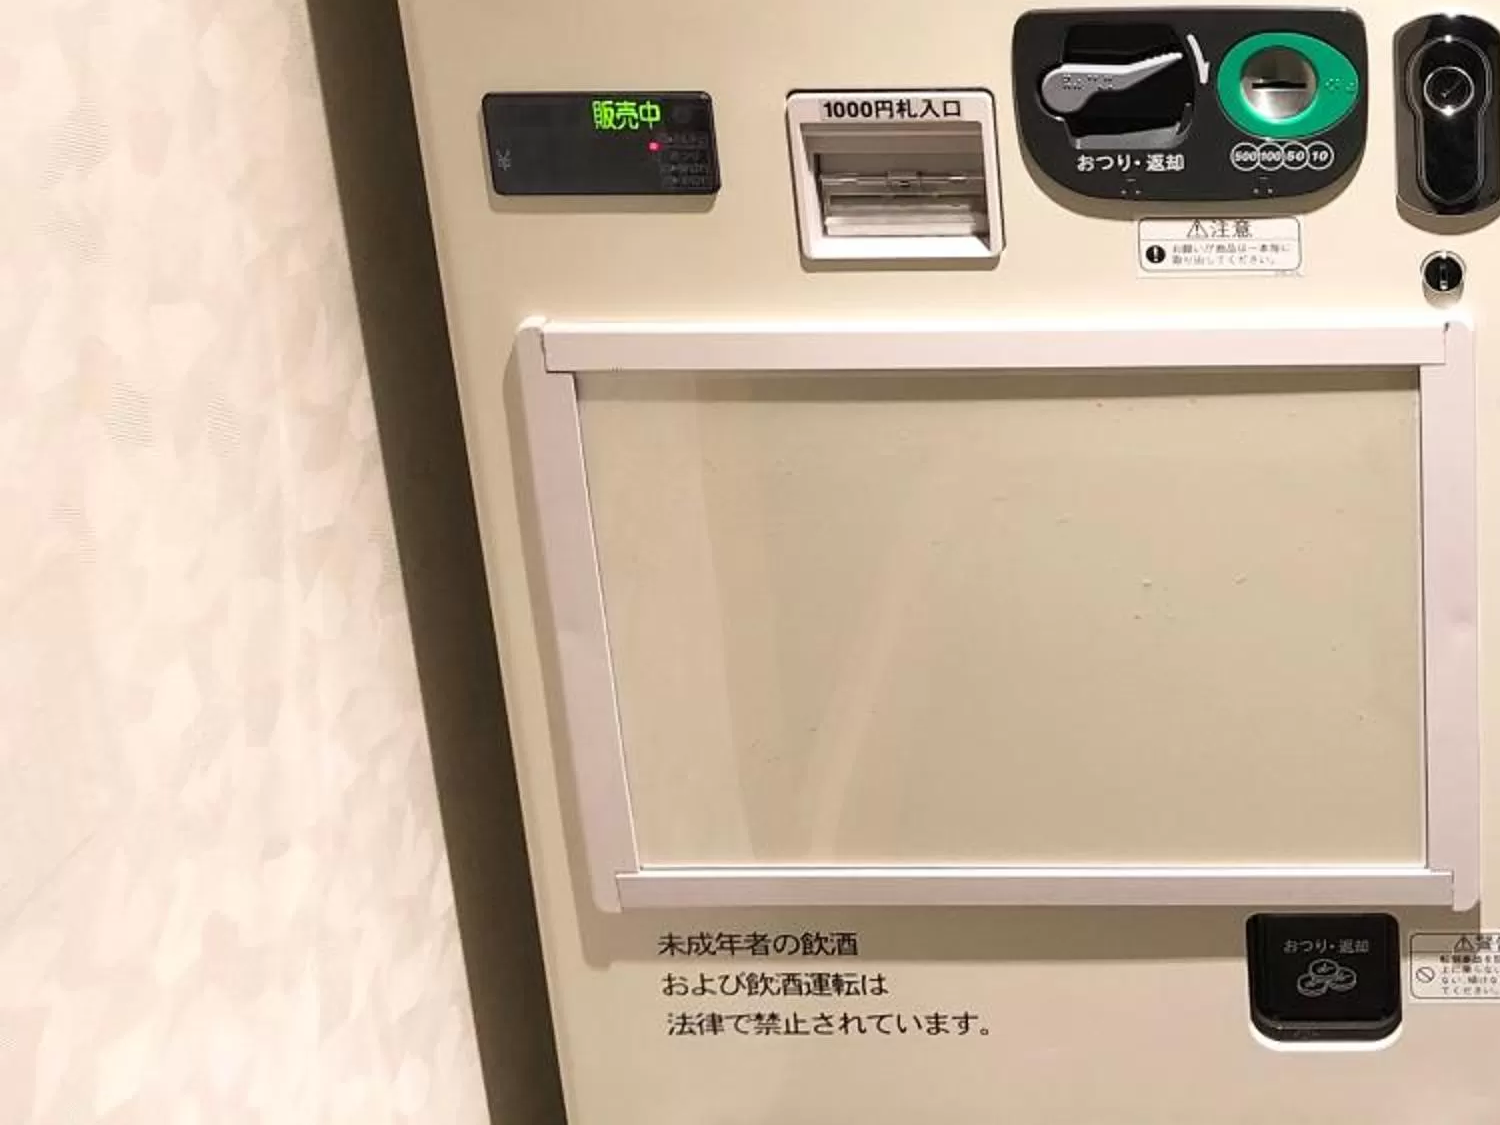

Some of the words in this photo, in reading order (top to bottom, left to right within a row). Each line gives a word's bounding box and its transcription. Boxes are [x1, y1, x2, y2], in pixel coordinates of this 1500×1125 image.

[592, 100, 661, 130] 販売中
[823, 99, 962, 120] 1000円札入口
[1077, 153, 1185, 172] おつり・返却
[1235, 150, 1257, 163] 500
[1260, 150, 1281, 163] 100
[1286, 150, 1305, 162] 50
[1311, 150, 1329, 162] 10
[1211, 219, 1253, 238] 注意
[658, 931, 858, 956] 未成年者の飲酒
[1283, 939, 1370, 955] おつり・返却
[662, 972, 889, 997] および飲酒運転は
[667, 1011, 990, 1037] 法律で禁止されています。
